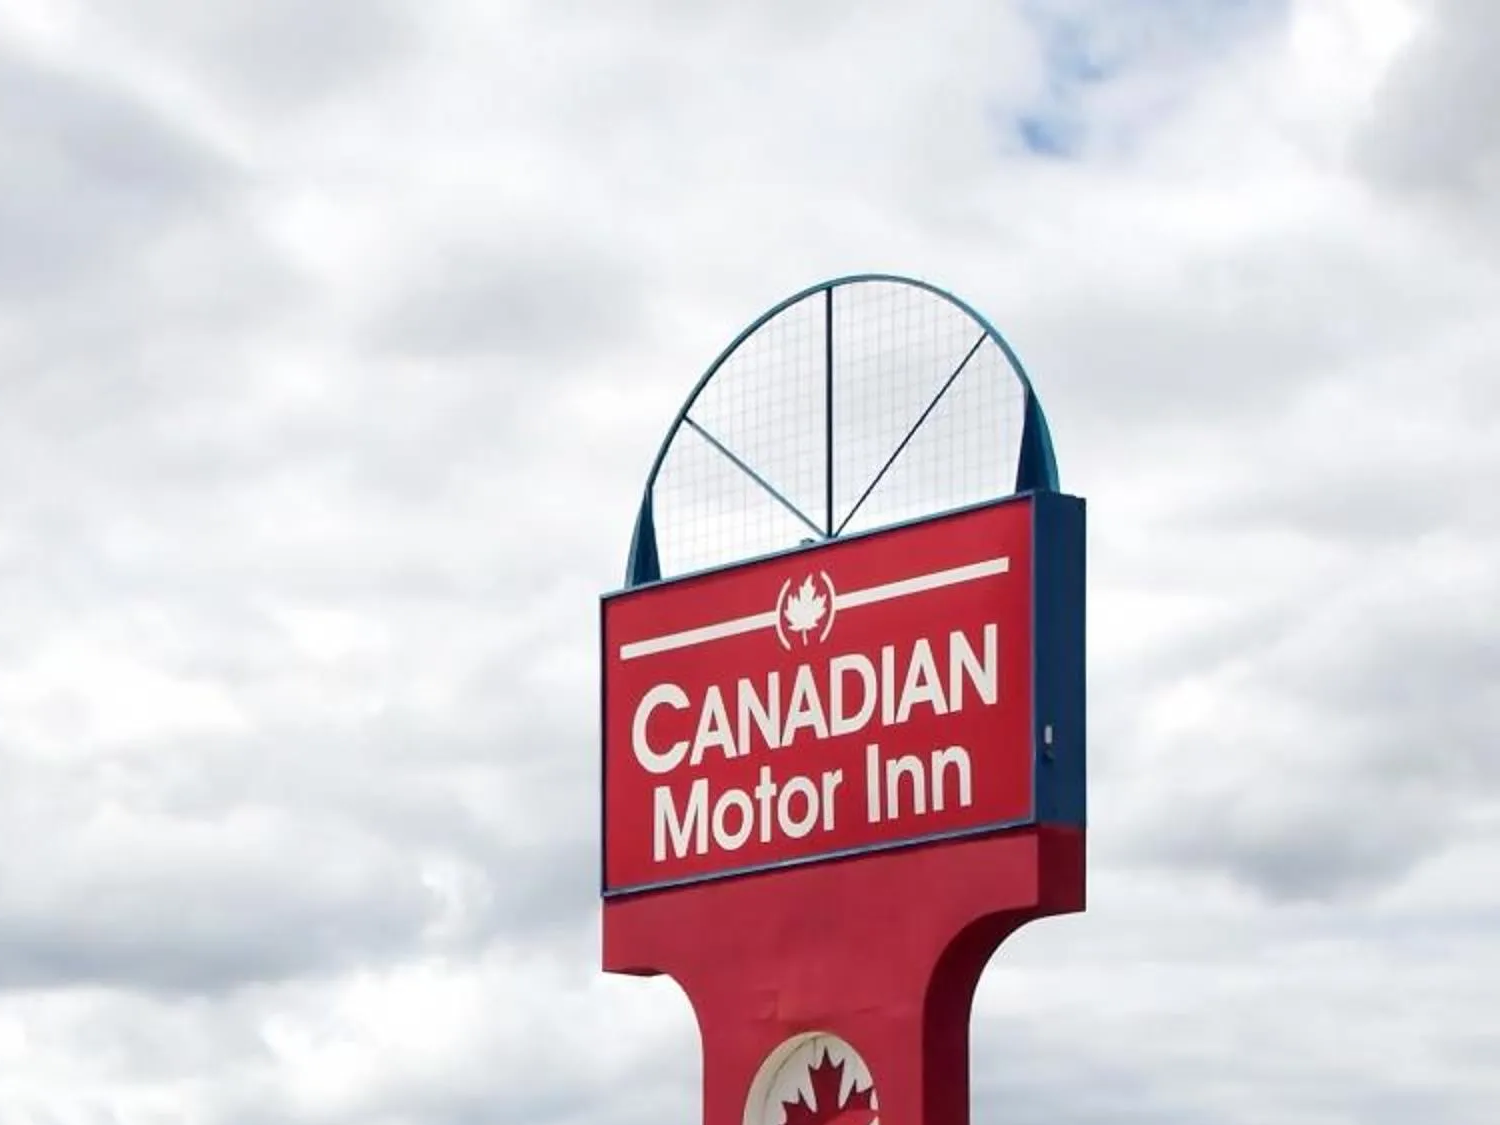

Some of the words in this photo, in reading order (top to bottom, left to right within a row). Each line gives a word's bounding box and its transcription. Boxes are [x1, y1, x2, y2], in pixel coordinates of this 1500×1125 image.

[632, 623, 997, 774] CANADIAN
[654, 765, 842, 862] Motor
[866, 743, 972, 823] Inn
